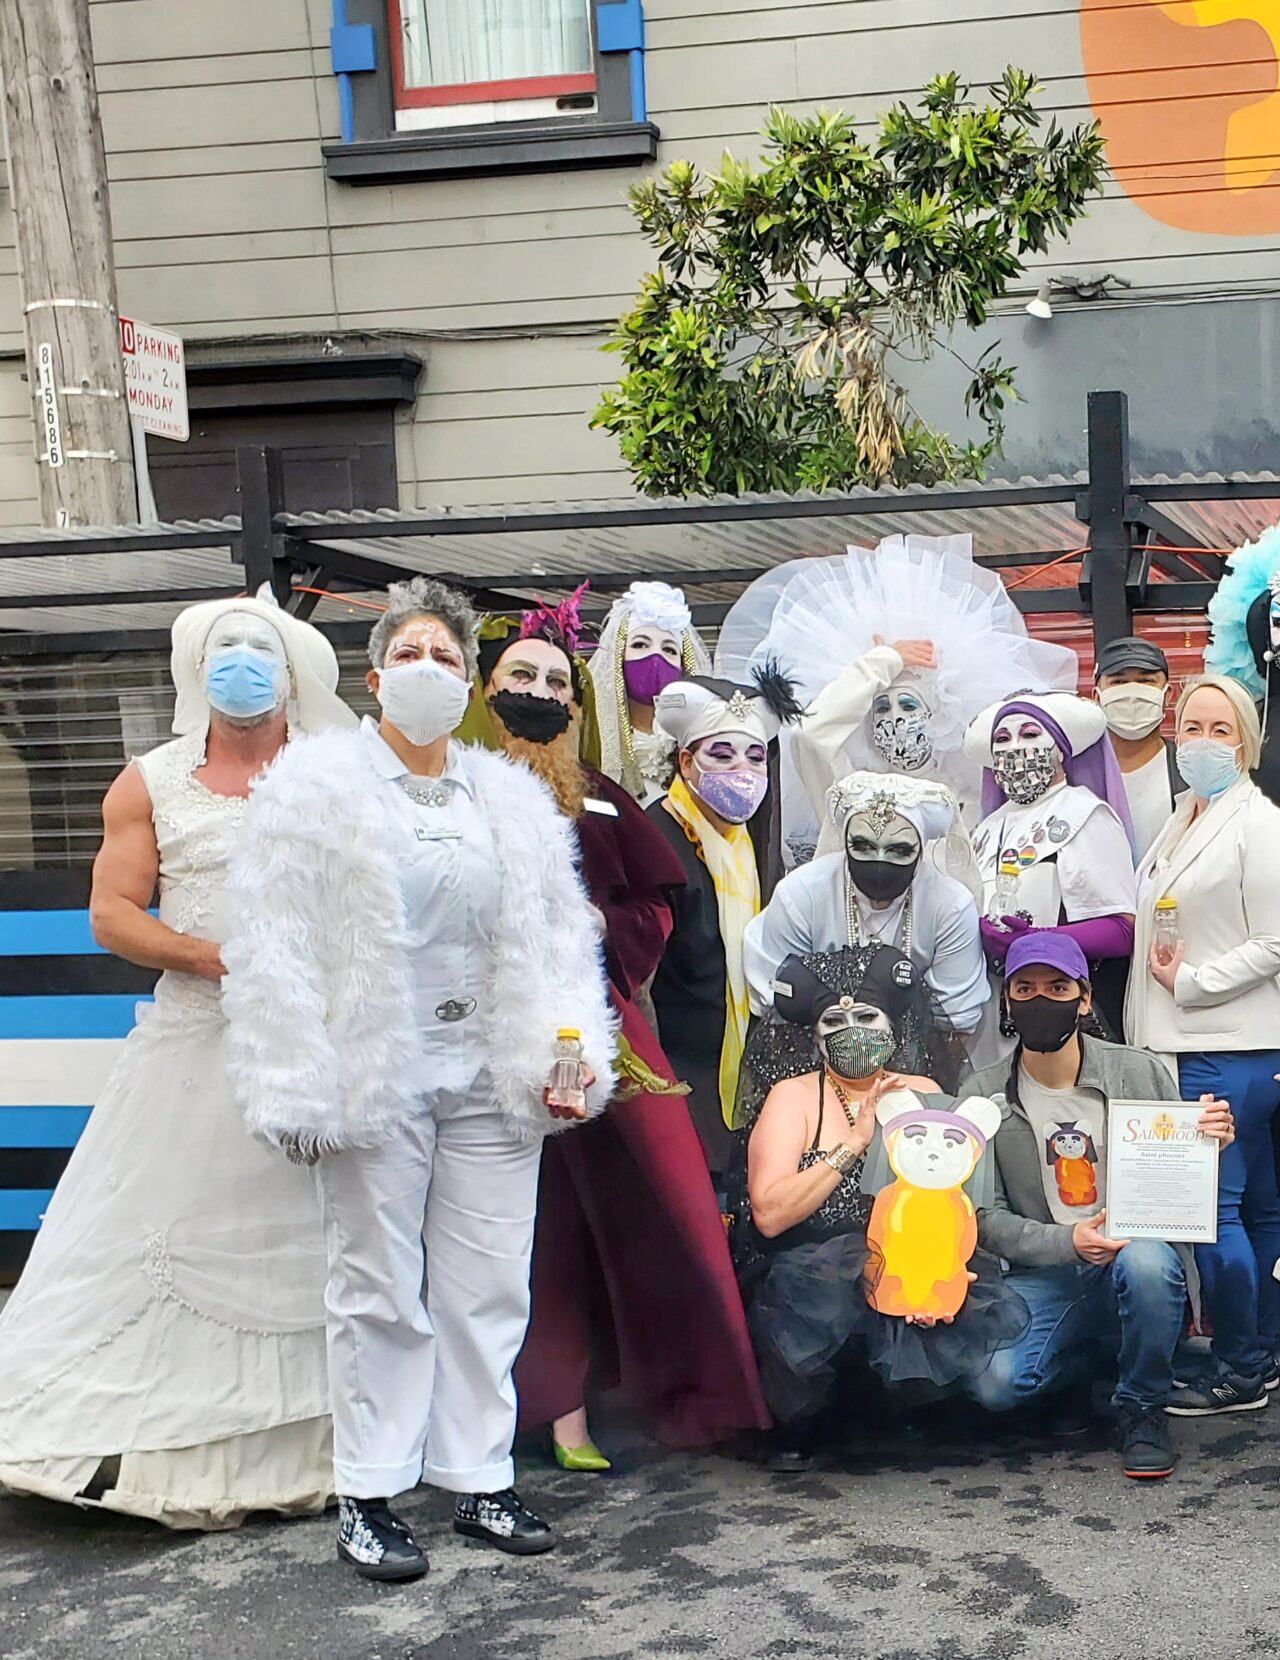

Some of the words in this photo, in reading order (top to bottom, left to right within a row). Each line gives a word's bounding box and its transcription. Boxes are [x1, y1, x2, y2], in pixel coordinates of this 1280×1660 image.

[136, 333, 181, 364] PARKING
[41, 347, 59, 464] 815686
[129, 387, 173, 413] MONDAY
